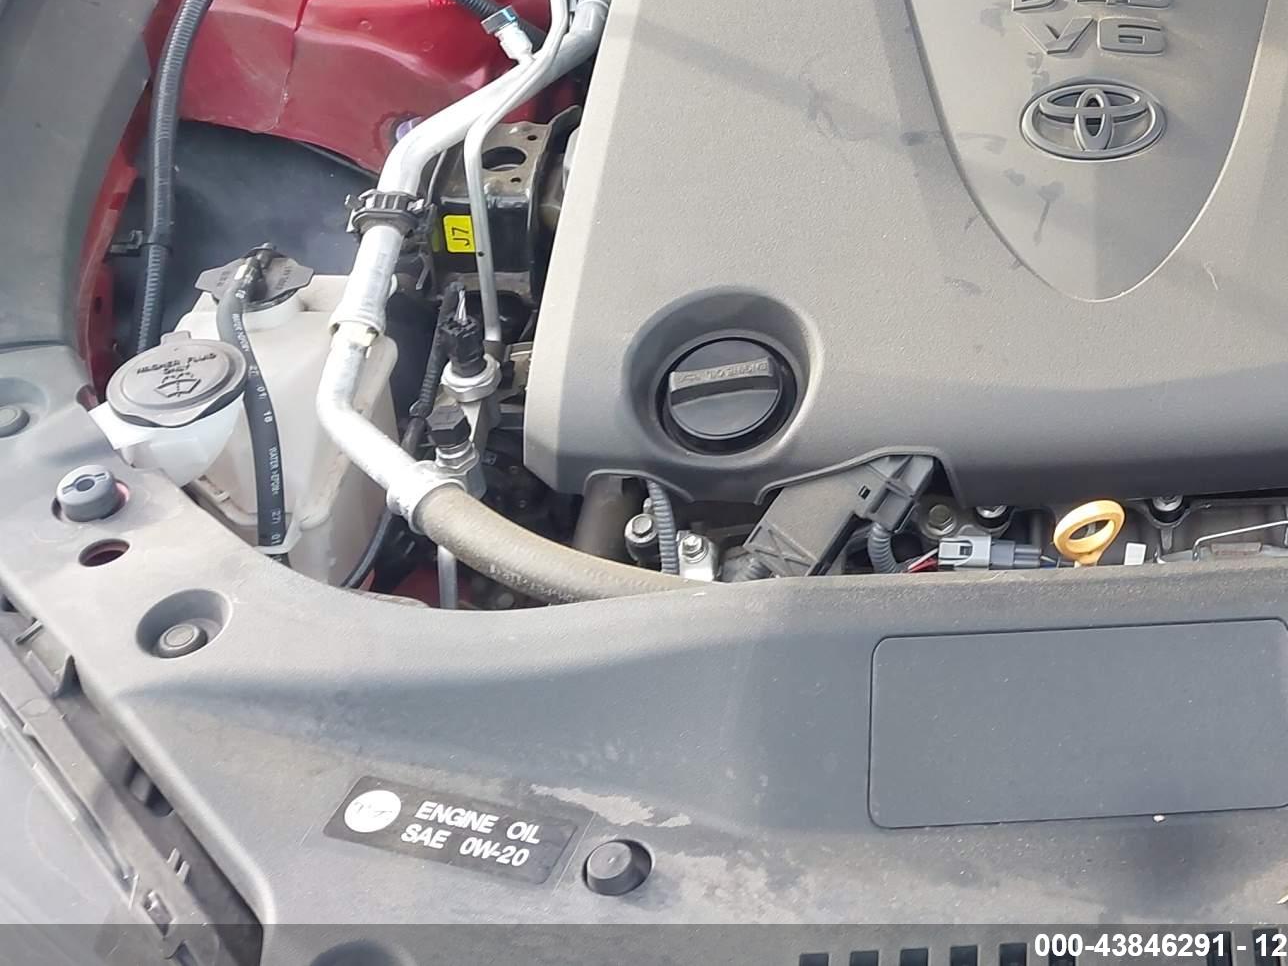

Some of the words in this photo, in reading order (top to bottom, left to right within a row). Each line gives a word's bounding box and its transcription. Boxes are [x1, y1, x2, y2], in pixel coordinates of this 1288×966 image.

[1020, 16, 1167, 56] V6
[414, 800, 499, 834] ENGINE
[506, 821, 542, 845] OIL
[400, 823, 451, 850] SAE
[458, 836, 530, 867] 0W-20
